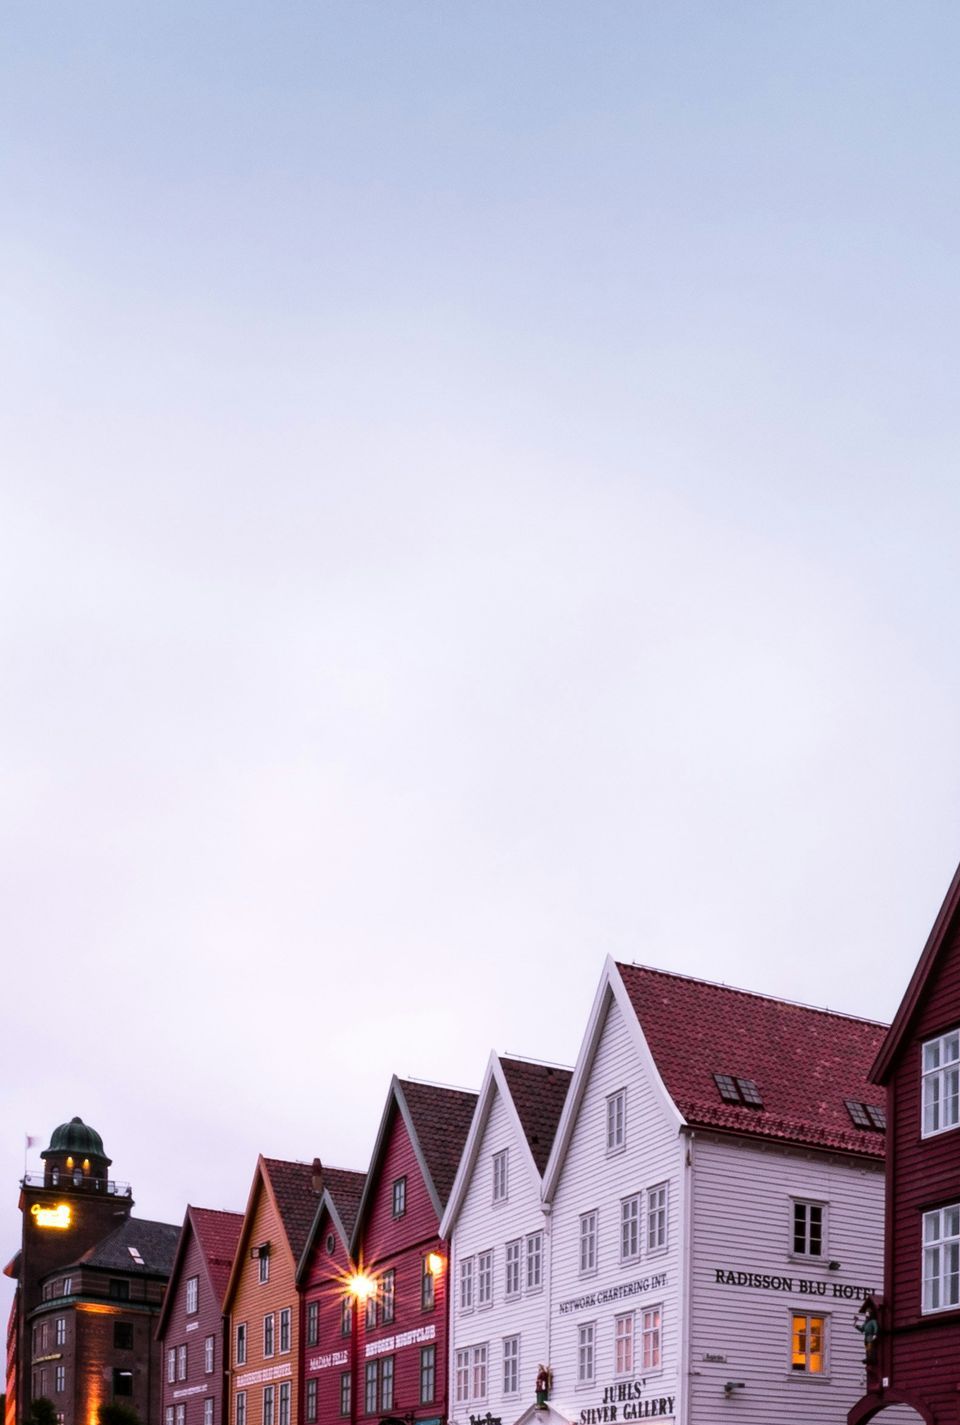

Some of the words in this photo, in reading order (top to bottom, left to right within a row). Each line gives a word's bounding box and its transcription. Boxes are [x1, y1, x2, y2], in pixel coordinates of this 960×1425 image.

[559, 1294, 596, 1314] NETWORK
[597, 1278, 650, 1304] CHARTERING
[715, 1268, 793, 1291] RADISSON
[799, 1279, 826, 1296] BLU
[579, 1405, 618, 1425] SILVER
[623, 1395, 676, 1420] GALLERY
